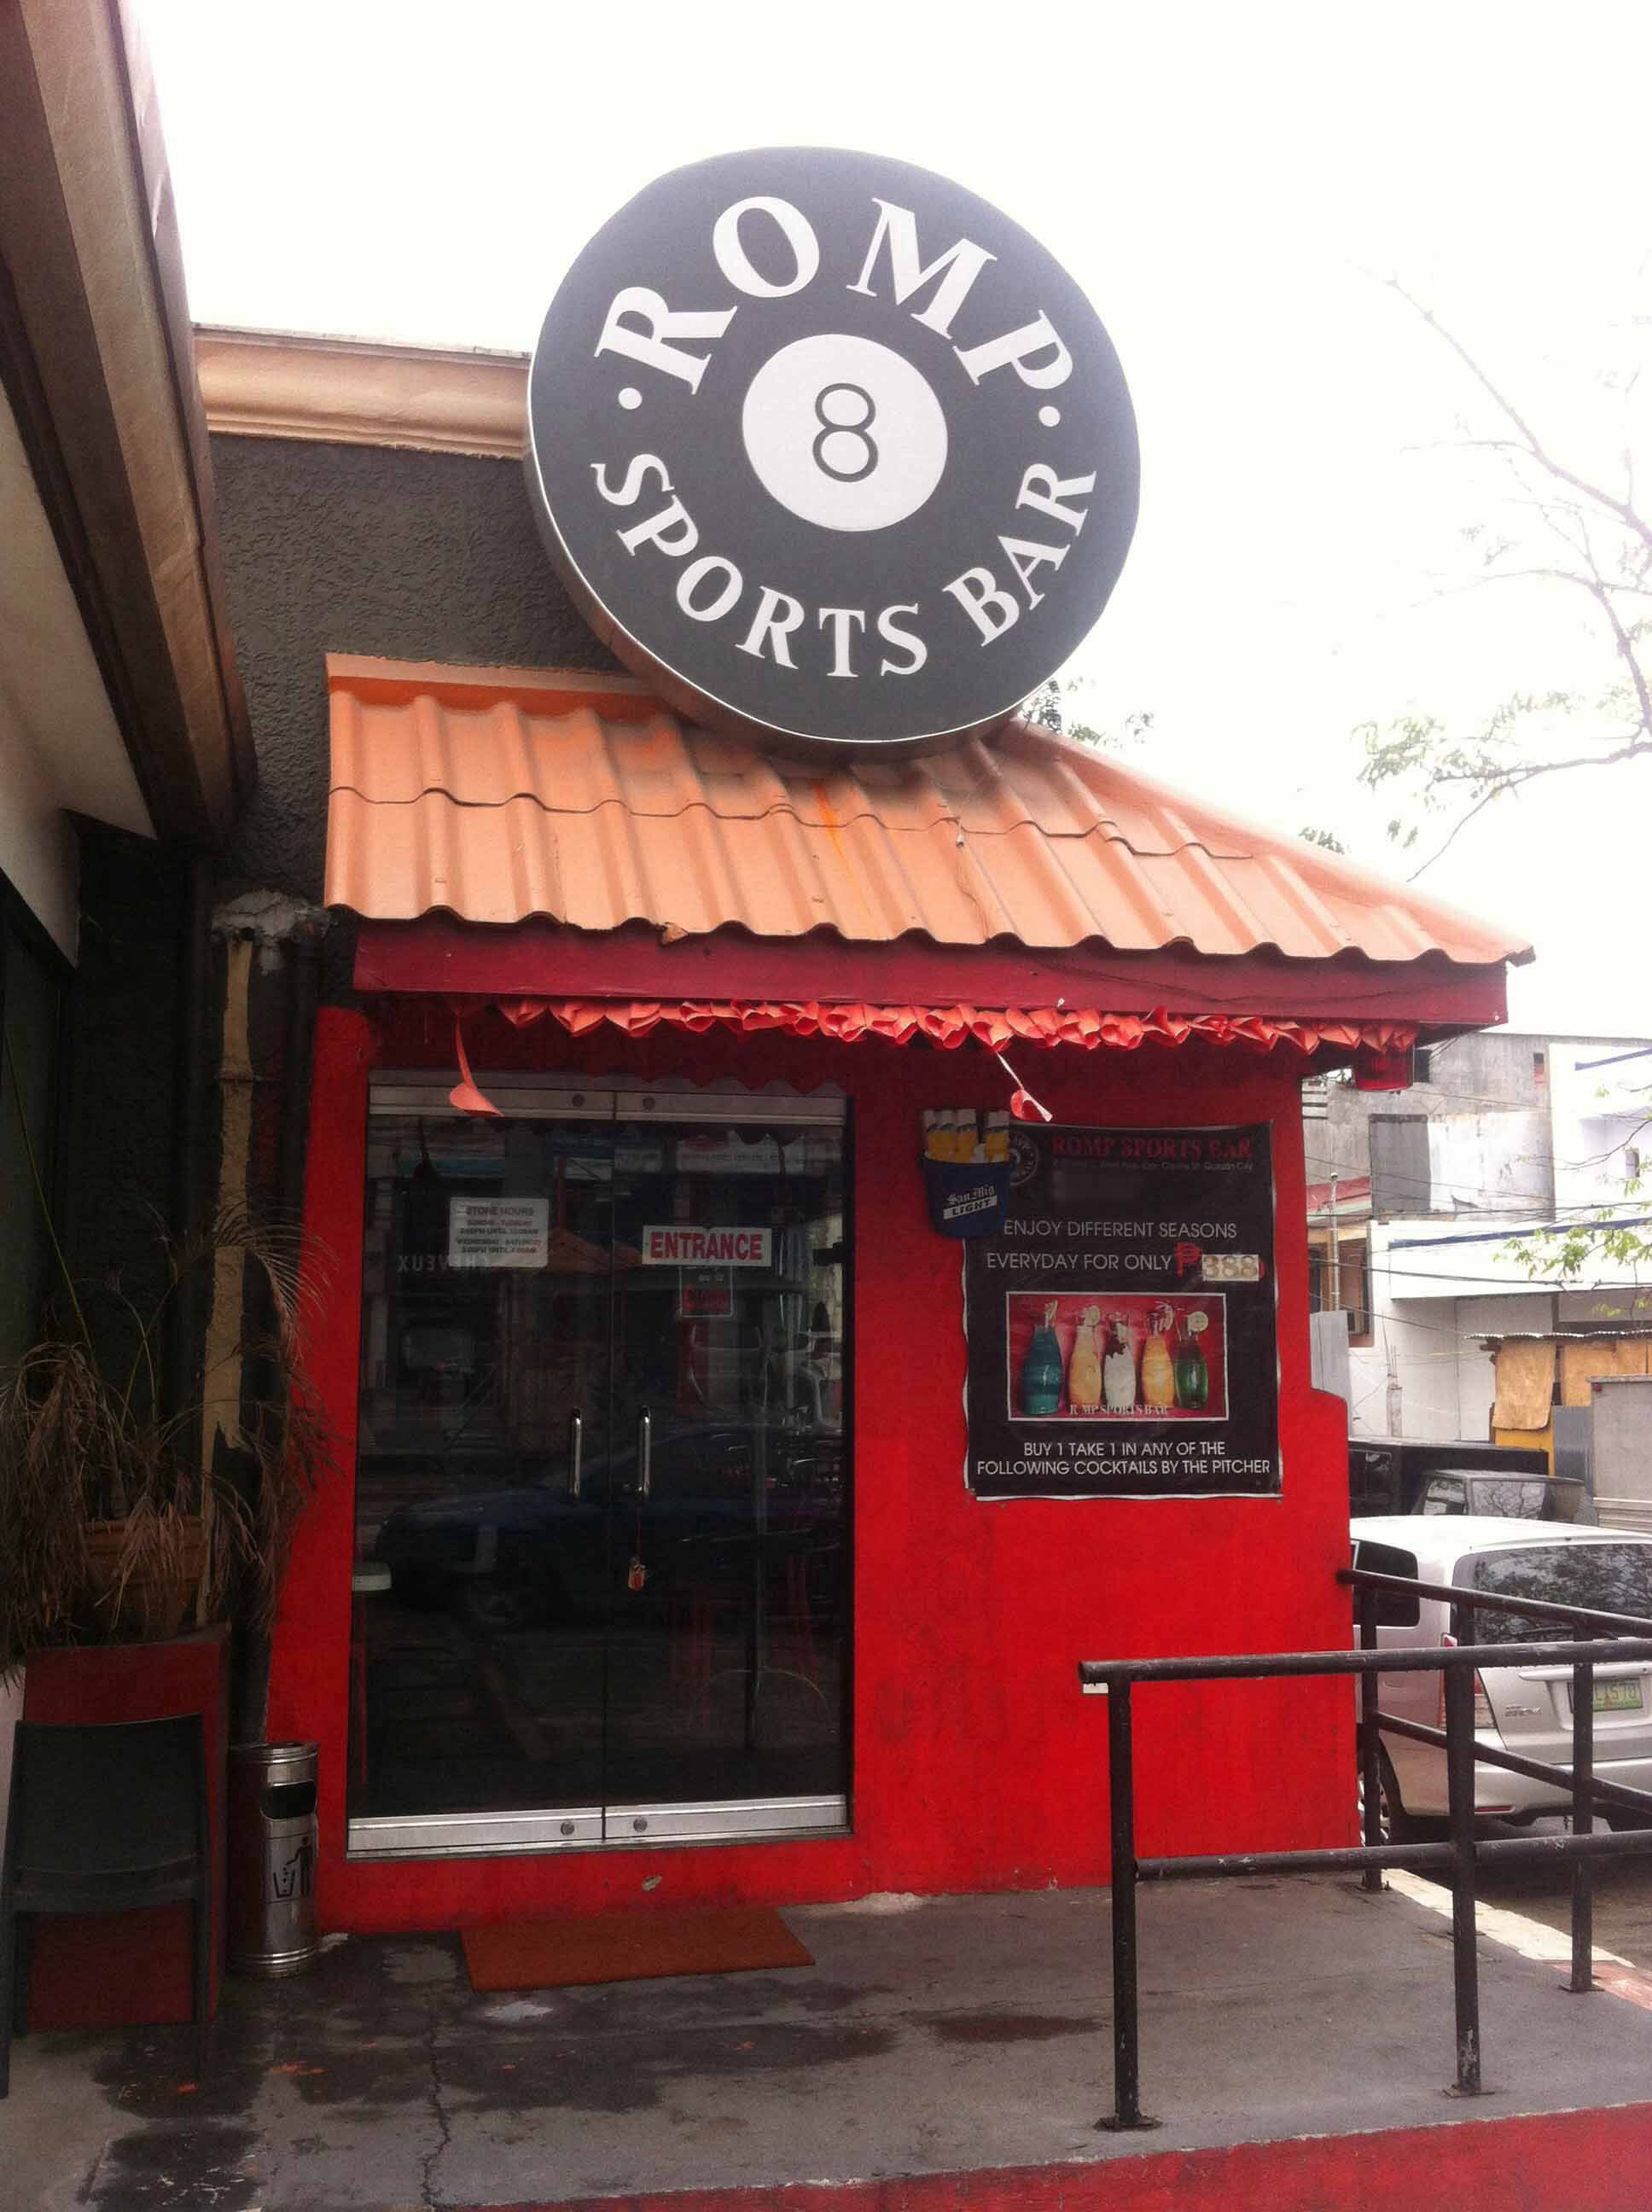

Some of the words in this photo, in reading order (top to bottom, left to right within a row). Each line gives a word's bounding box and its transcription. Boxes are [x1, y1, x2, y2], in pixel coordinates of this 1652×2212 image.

[594, 195, 1073, 394] ROMP
[811, 381, 879, 484] 8
[591, 453, 928, 678] SPORTS
[942, 463, 1097, 648] BAR
[1003, 1220, 1062, 1237] ENJOY
[1067, 1221, 1154, 1237] DIFFERENT
[1159, 1222, 1237, 1239] SEASONS
[650, 1231, 764, 1260] ENTRANCE
[986, 1253, 1079, 1270] EVERYDAY
[1085, 1254, 1120, 1271] FOR
[1125, 1254, 1172, 1272] ONLY
[1023, 1442, 1052, 1456] BUY
[1057, 1442, 1063, 1456] 1
[1068, 1442, 1105, 1456] TAKE
[1109, 1442, 1115, 1456] 1
[1121, 1442, 1137, 1456] IN
[1142, 1442, 1174, 1456] ANY
[1177, 1441, 1196, 1456] OF
[1199, 1441, 1226, 1455] THE
[977, 1460, 1071, 1476] FOLLOWING
[1074, 1459, 1158, 1476] COCKTAILS
[1161, 1459, 1179, 1475] BY
[1181, 1459, 1208, 1475] THE
[1211, 1458, 1271, 1474] PITCHER
